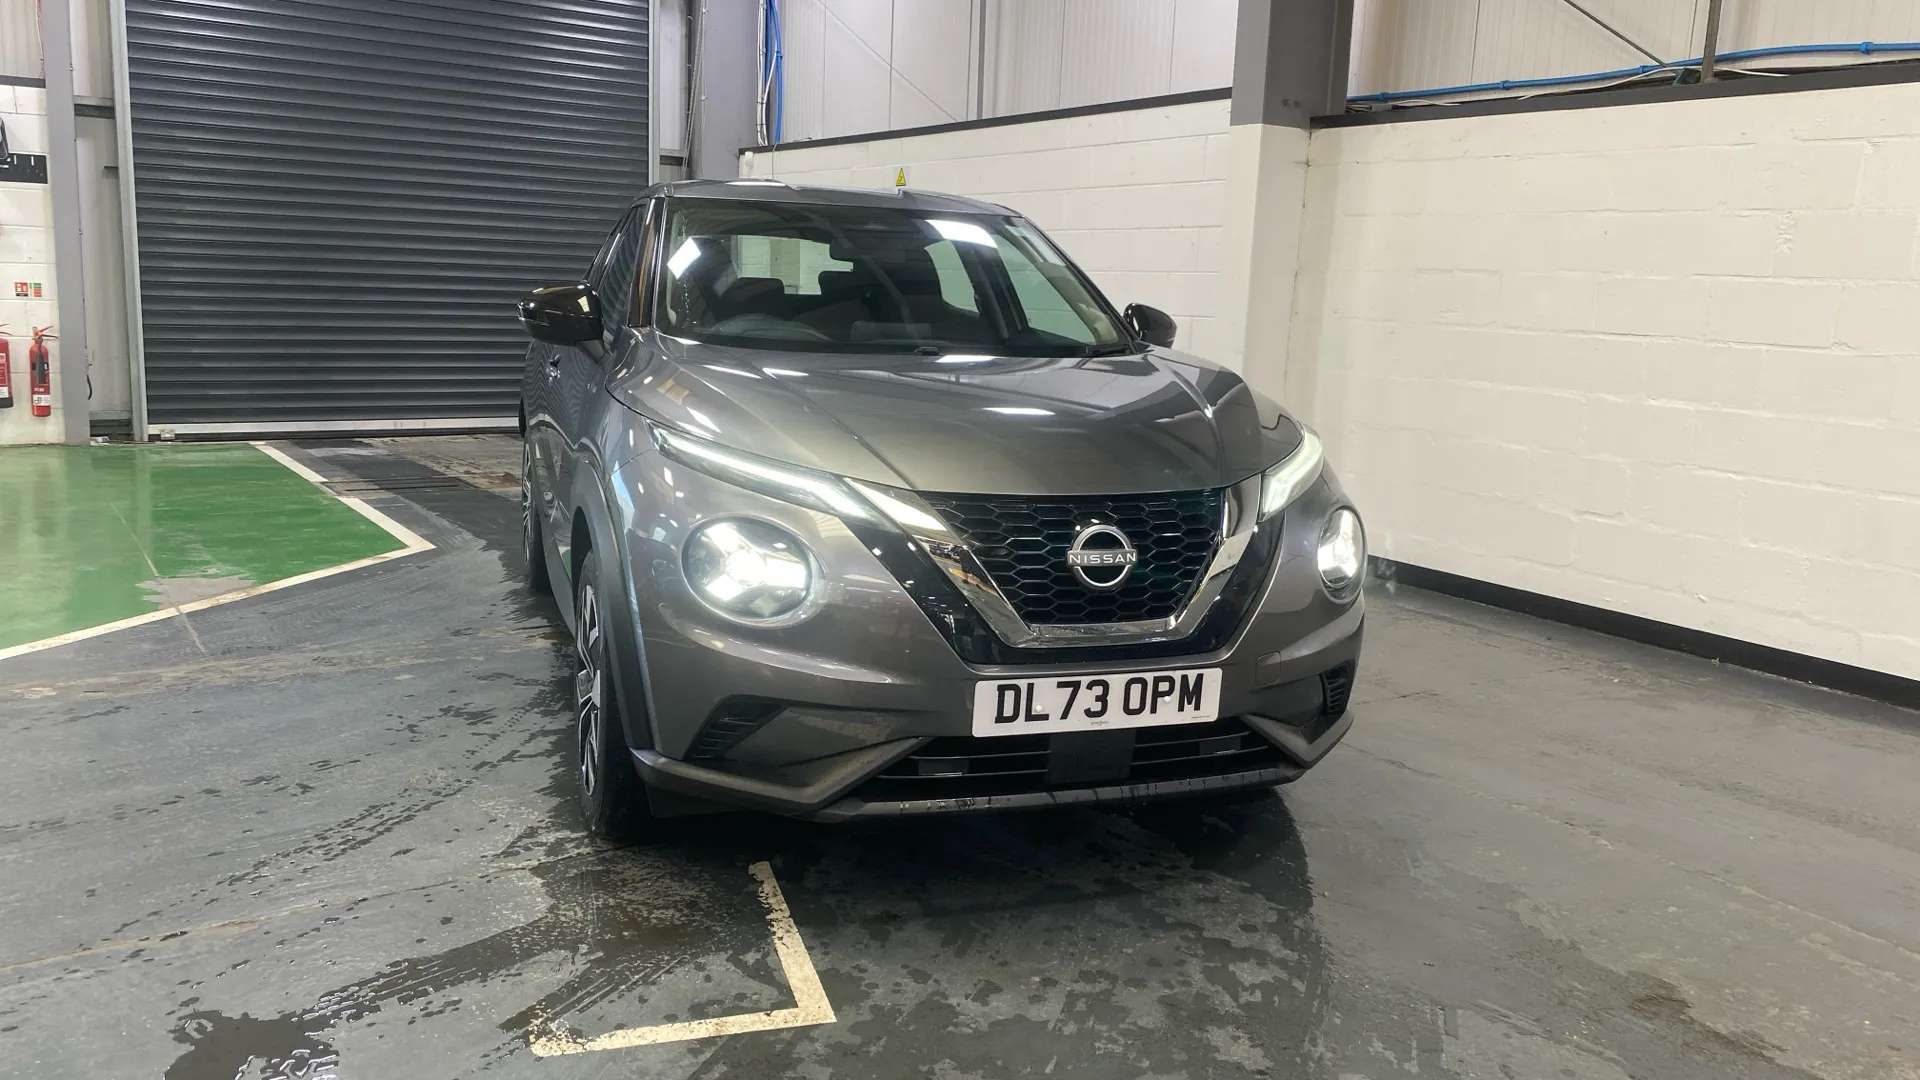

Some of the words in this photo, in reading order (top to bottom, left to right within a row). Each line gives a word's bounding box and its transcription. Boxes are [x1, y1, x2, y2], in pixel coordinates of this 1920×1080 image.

[1069, 552, 1136, 564] NISSAN
[994, 679, 1110, 724] DL73
[1122, 673, 1204, 716] OPM
